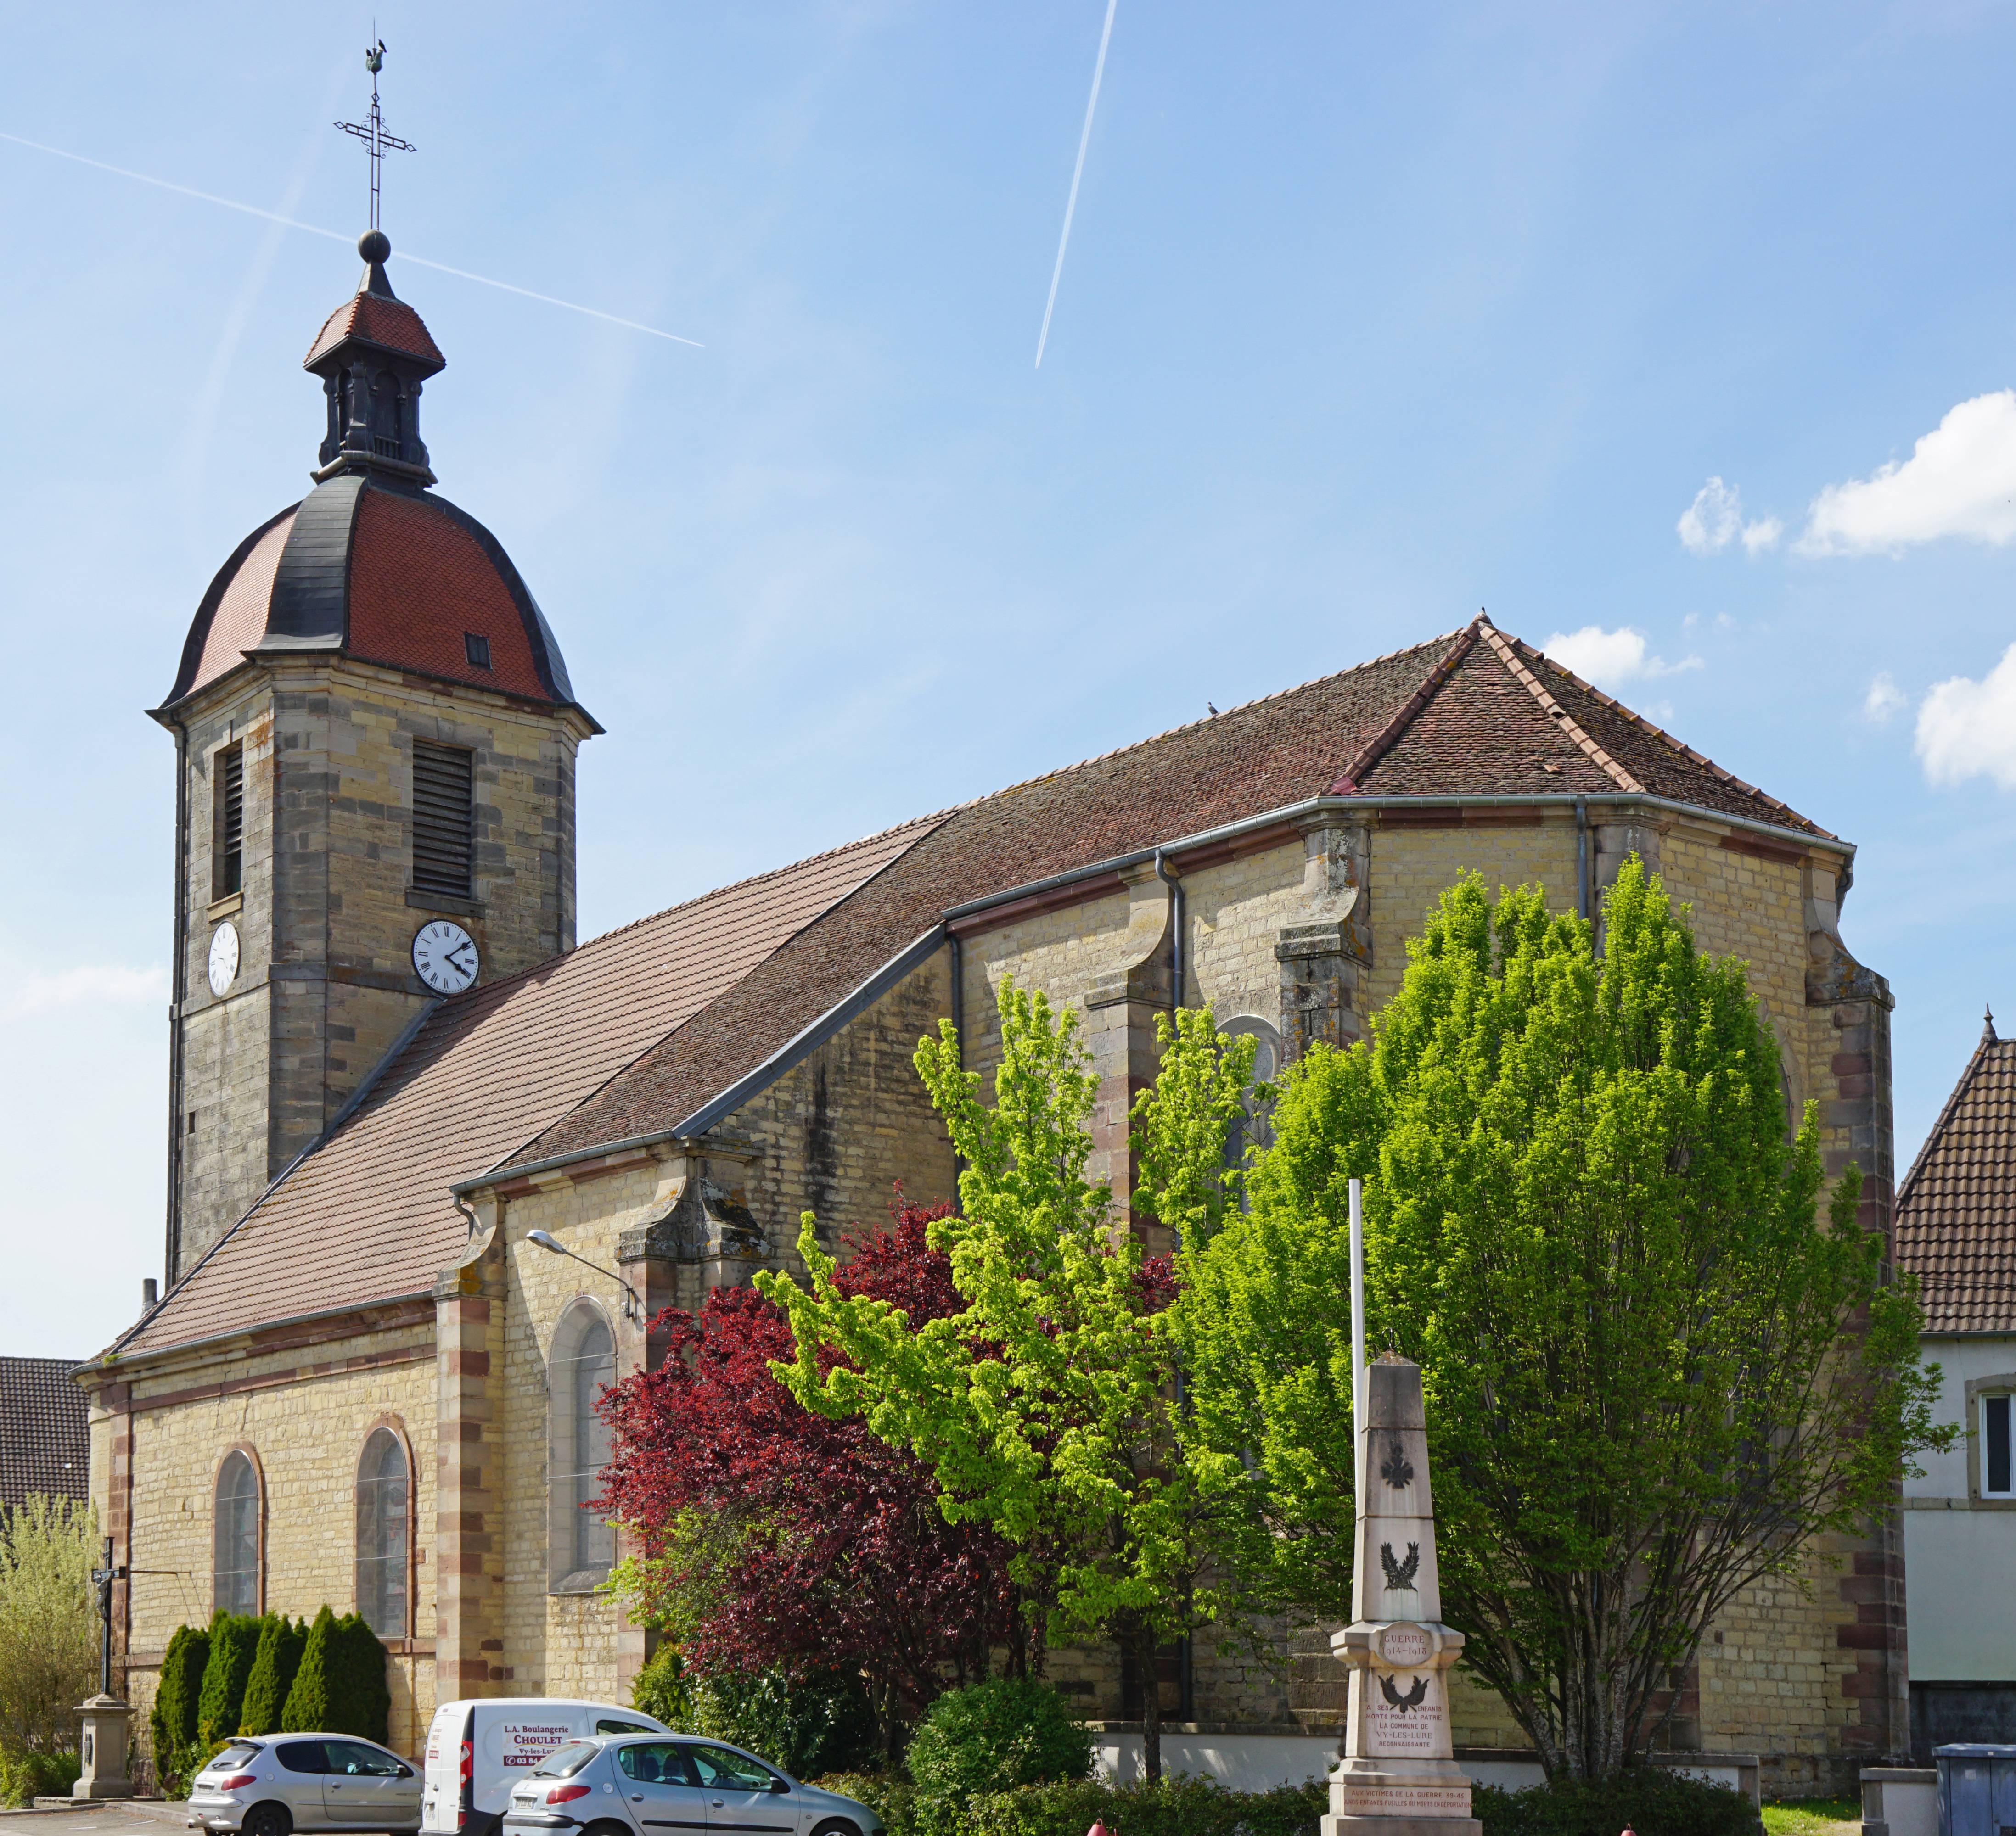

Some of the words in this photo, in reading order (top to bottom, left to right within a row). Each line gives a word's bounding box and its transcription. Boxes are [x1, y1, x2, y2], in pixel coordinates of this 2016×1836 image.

[1384, 1635, 1424, 1643] GUERRE
[522, 1725, 569, 1735] Boulangerie
[514, 1735, 562, 1744] CHOULET
